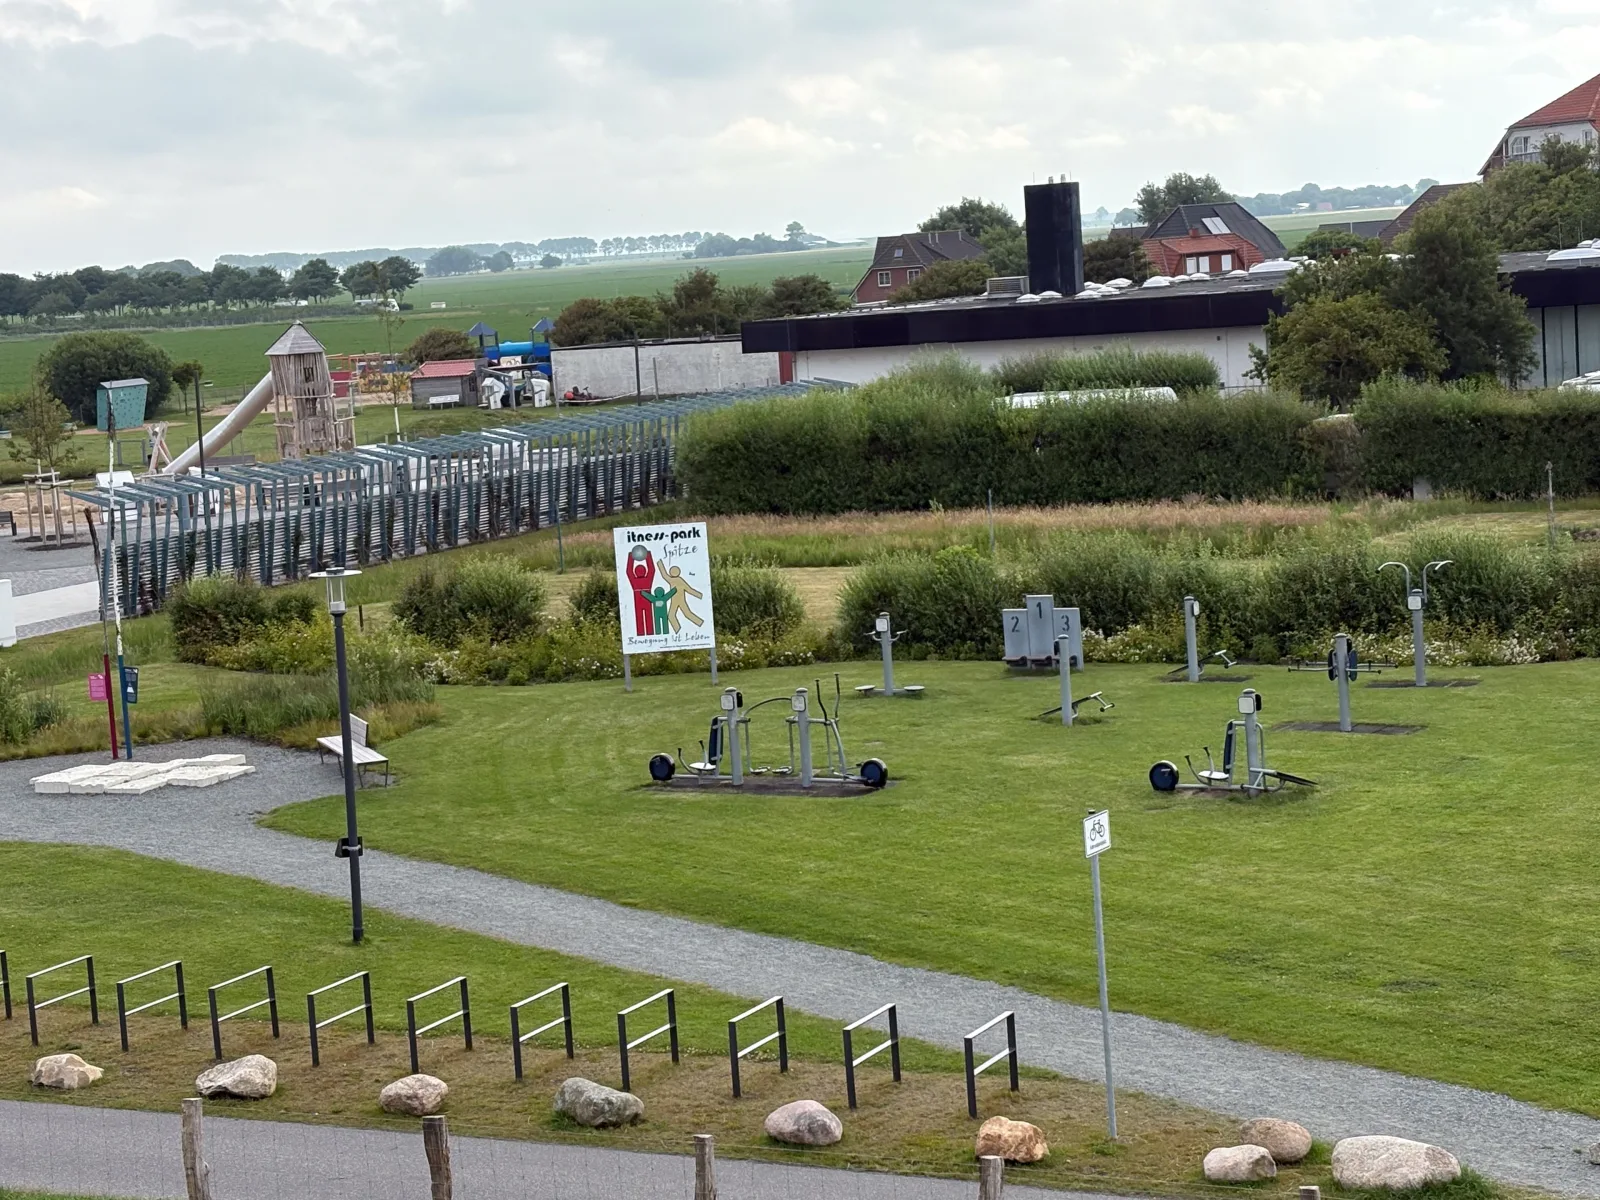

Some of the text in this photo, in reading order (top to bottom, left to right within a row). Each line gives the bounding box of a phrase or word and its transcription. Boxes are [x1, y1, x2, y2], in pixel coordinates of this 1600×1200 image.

[663, 543, 698, 566] Spitze
[1036, 602, 1042, 619] 1
[1011, 616, 1020, 632] 2
[1061, 615, 1070, 631] 3
[627, 636, 668, 647] Bewegung
[684, 631, 710, 641] Leben
